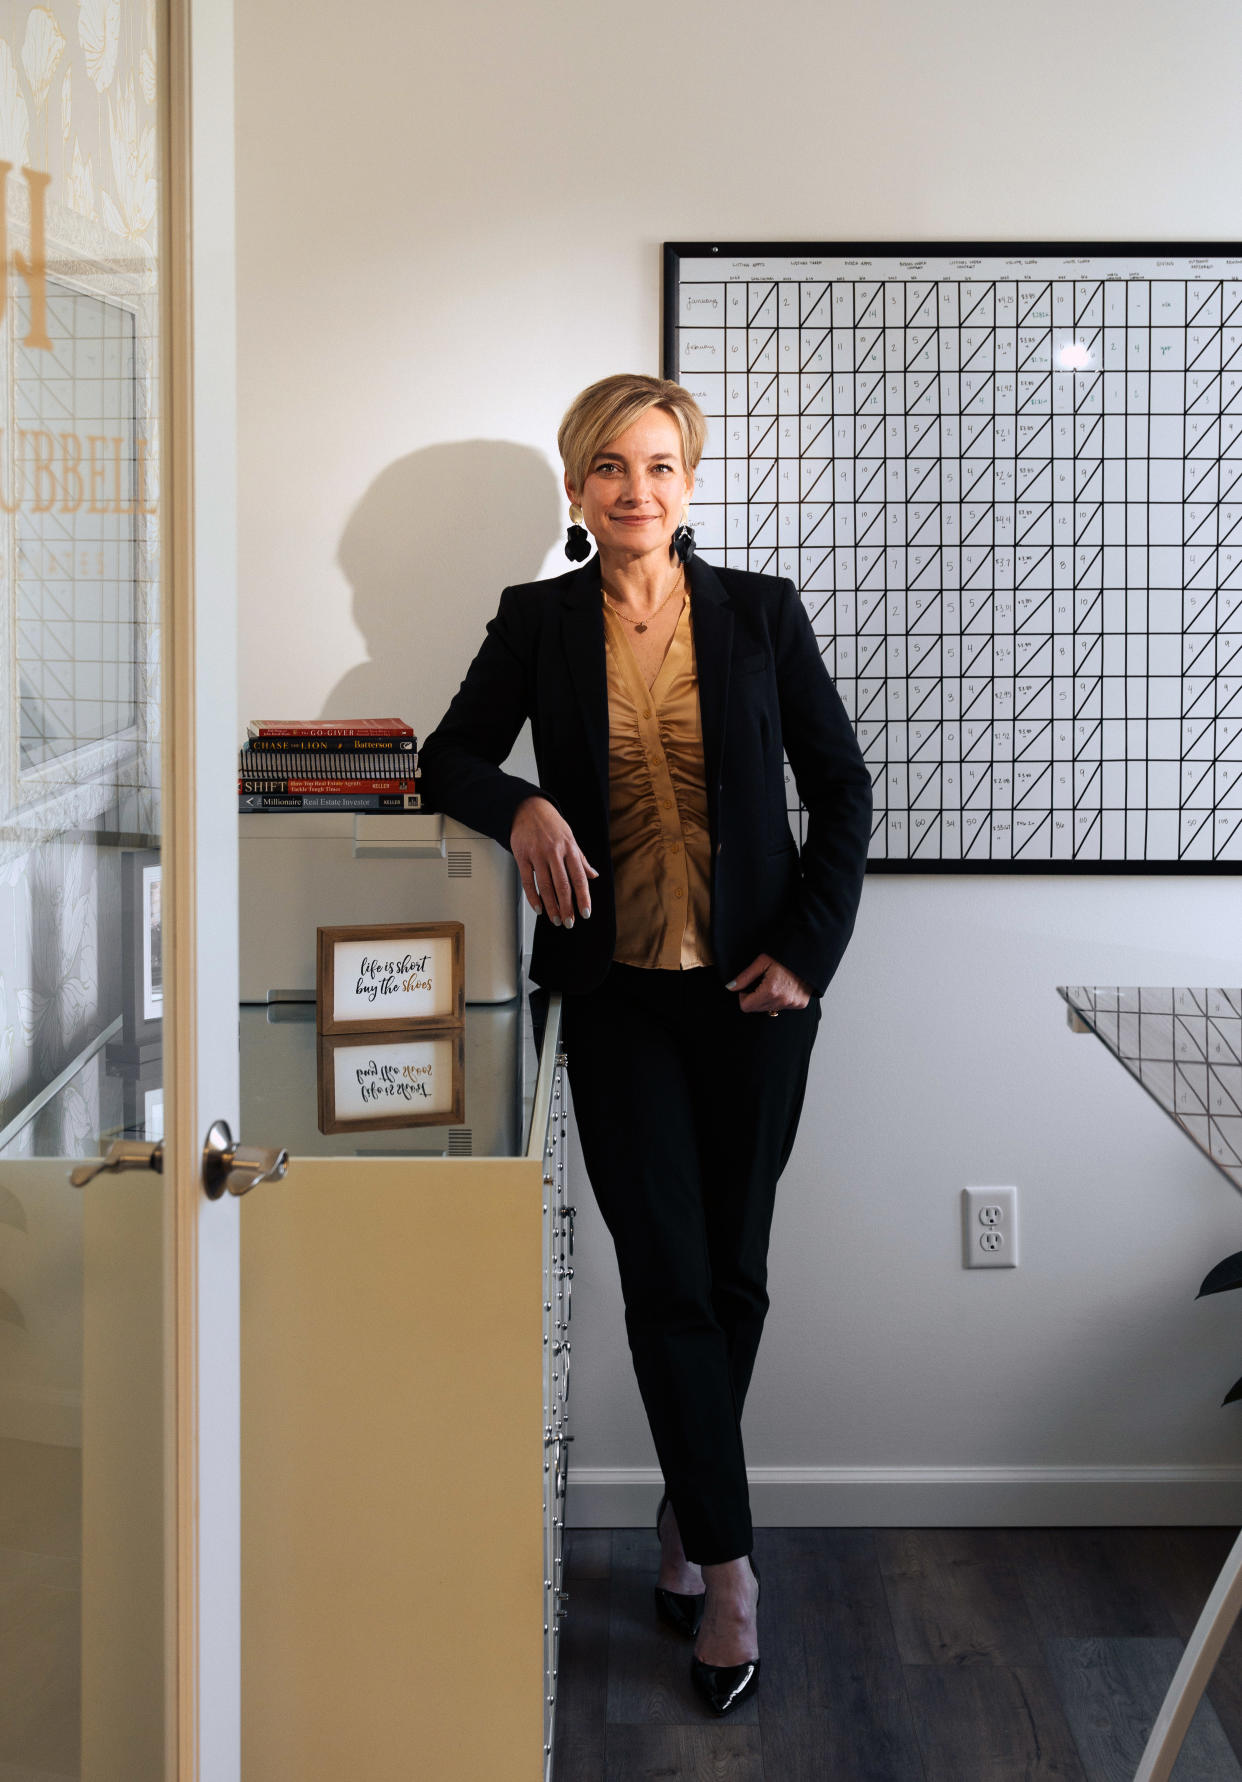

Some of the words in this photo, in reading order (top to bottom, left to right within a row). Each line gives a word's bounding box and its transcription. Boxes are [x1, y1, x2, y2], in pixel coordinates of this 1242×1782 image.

[732, 298, 739, 306] 6
[783, 298, 790, 307] 2
[913, 290, 920, 299] 5
[943, 294, 951, 304] 4
[1080, 288, 1087, 296] 9
[868, 308, 877, 318] 14
[731, 344, 739, 353] 6
[805, 338, 811, 346] 4
[837, 342, 843, 351] 11
[891, 344, 897, 352] 2
[912, 336, 919, 344] 5
[944, 341, 951, 350] 2
[966, 337, 972, 346] 4
[731, 389, 739, 400] 6
[838, 385, 844, 394] 11
[891, 386, 898, 394] 5
[913, 380, 920, 388] 5
[1079, 381, 1085, 391] 9
[733, 431, 740, 441] 5
[784, 428, 791, 438] 2
[891, 427, 898, 437] 3
[913, 424, 920, 433] 5
[946, 428, 953, 436] 2
[967, 425, 973, 434] 4
[1079, 423, 1086, 432] 9
[734, 472, 740, 482] 9
[783, 472, 789, 480] 4
[840, 472, 847, 482] 9
[946, 473, 953, 482] 5
[967, 468, 974, 477] 4
[1059, 473, 1066, 482] 6
[1081, 468, 1087, 478] 9
[733, 518, 739, 528] 7
[785, 516, 791, 526] 3
[841, 516, 848, 526] 7
[892, 514, 898, 524] 3
[913, 511, 920, 520] 5
[946, 515, 953, 525] 2
[969, 510, 976, 519] 5
[1058, 517, 1067, 525] 12
[783, 562, 792, 571] 6
[806, 556, 812, 564] 4
[841, 561, 848, 570] 5
[892, 559, 898, 569] 7
[914, 556, 922, 565] 5
[946, 561, 954, 572] 5
[1059, 560, 1067, 570] 8
[1080, 554, 1086, 564] 9
[842, 604, 849, 614] 7
[892, 606, 900, 617] 2
[915, 599, 922, 609] 5
[946, 602, 955, 613] 5
[969, 598, 975, 608] 5
[1080, 598, 1088, 606] 10
[840, 651, 848, 660] 10
[893, 648, 900, 658] 3
[913, 643, 921, 652] 5
[947, 648, 955, 658] 5
[967, 644, 973, 653] 4
[1059, 647, 1066, 656] 8
[1081, 641, 1088, 651] 9
[914, 686, 921, 694] 5
[947, 693, 954, 703] 3
[968, 684, 974, 694] 4
[1059, 691, 1067, 701] 5
[1080, 682, 1086, 692] 9
[915, 730, 922, 738] 5
[968, 728, 973, 737] 4
[1079, 726, 1085, 735] 9
[254, 741, 288, 750] CHASE
[301, 741, 327, 750] LION
[354, 740, 392, 749] Batterson
[892, 777, 898, 785] 4
[916, 772, 923, 780] 5
[969, 770, 975, 779] 4
[1079, 768, 1085, 777] 9
[245, 781, 286, 792] SHIFT
[891, 821, 902, 830] 47
[914, 818, 926, 828] 60
[966, 818, 977, 826] 50
[361, 957, 383, 979] life
[385, 962, 394, 974] is
[397, 955, 431, 974] short
[356, 978, 377, 1002] buy
[379, 976, 400, 995] the
[402, 973, 432, 992] shoes
